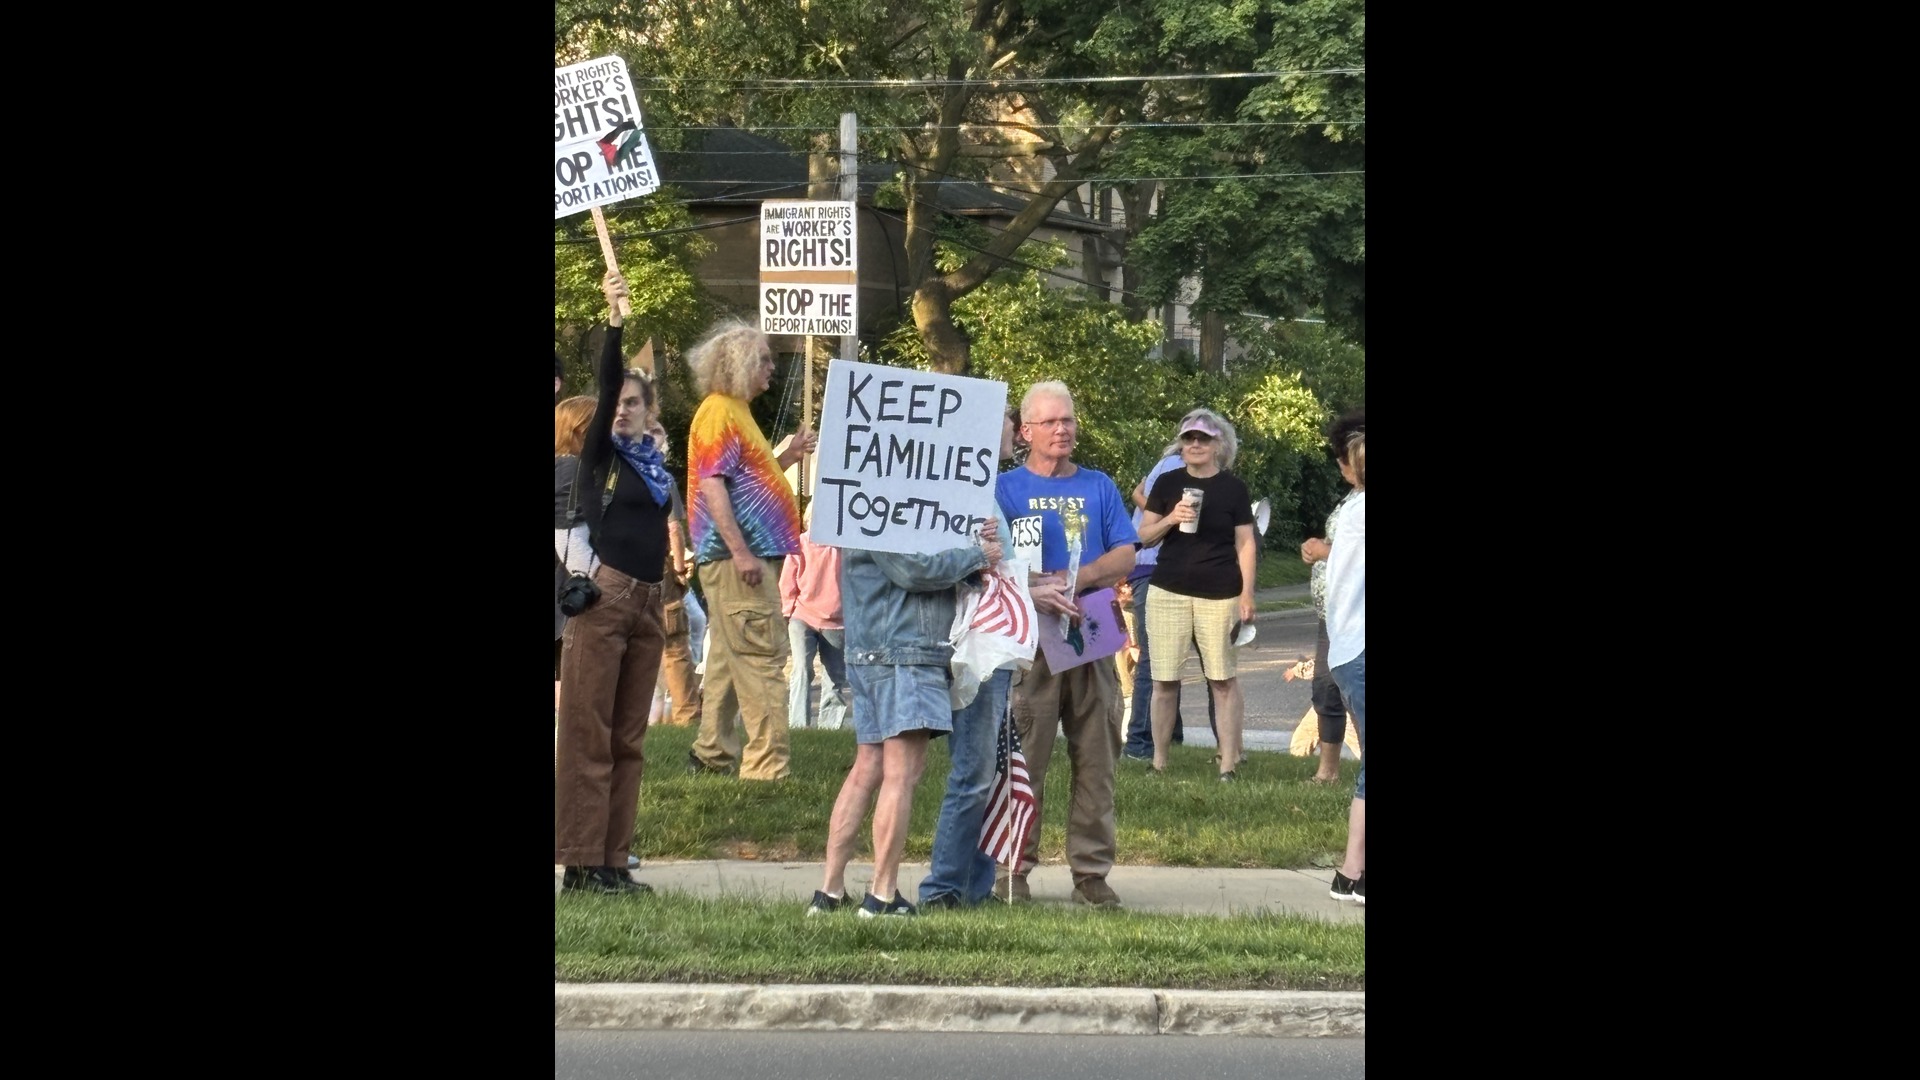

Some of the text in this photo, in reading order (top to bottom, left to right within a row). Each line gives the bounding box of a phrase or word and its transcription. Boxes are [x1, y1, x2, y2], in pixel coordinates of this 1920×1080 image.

[555, 61, 620, 88] NT RIGHTS
[555, 151, 592, 189] OP
[764, 206, 851, 220] IMMIGRANT RIGHTS
[766, 220, 851, 237] ARE WORKER'S
[766, 238, 851, 267] RIGHTS!
[765, 288, 852, 316] STOP THE
[764, 318, 851, 334] DEPORTATIONS!
[846, 370, 962, 428] KEEP
[844, 424, 992, 487] FAMILIES
